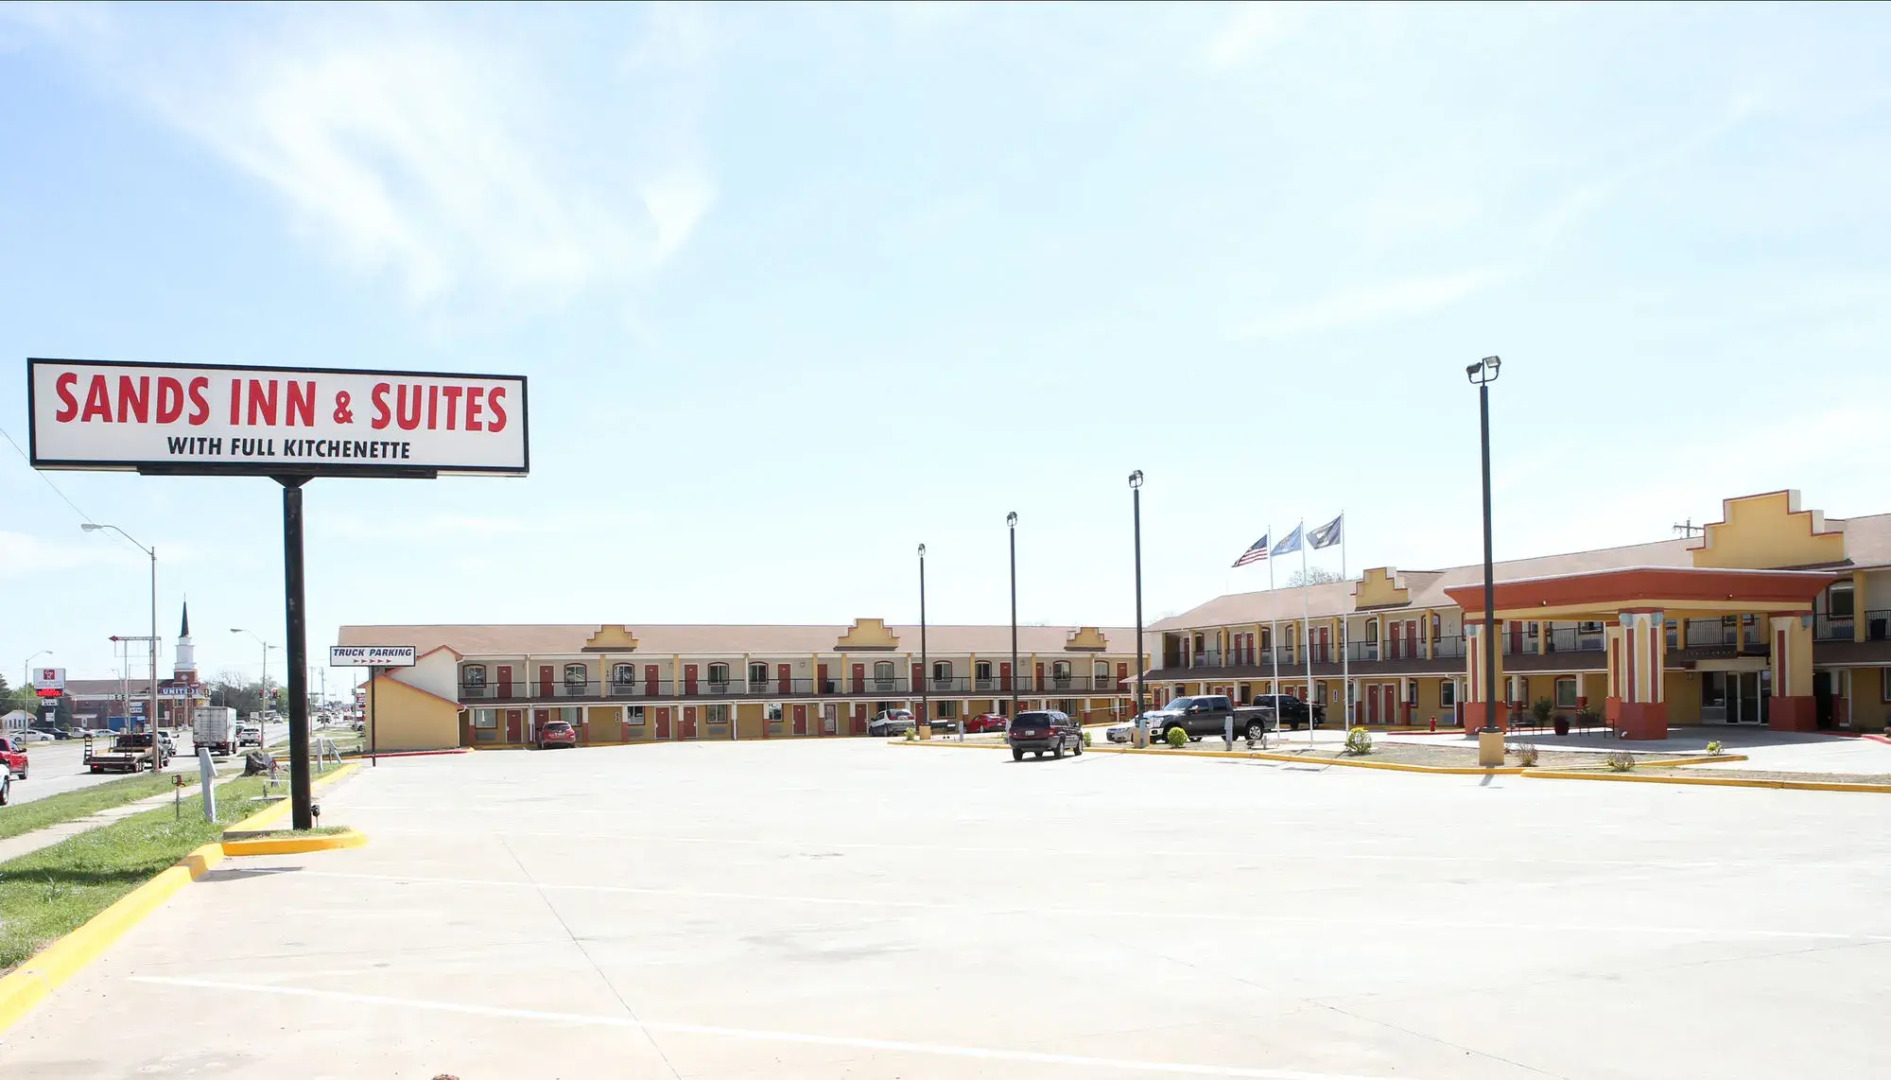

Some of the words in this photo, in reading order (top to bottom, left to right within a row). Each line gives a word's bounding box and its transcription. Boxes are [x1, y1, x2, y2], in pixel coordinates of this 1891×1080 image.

[55, 372, 210, 426] SANDS
[229, 378, 316, 427] INN
[333, 390, 354, 424] &
[371, 382, 507, 433] SUITES
[166, 436, 222, 455] WITH
[230, 438, 275, 456] FULL
[283, 438, 411, 459] KITCHENETTE
[333, 648, 365, 657] TRUCK
[369, 648, 412, 657] PARKING
